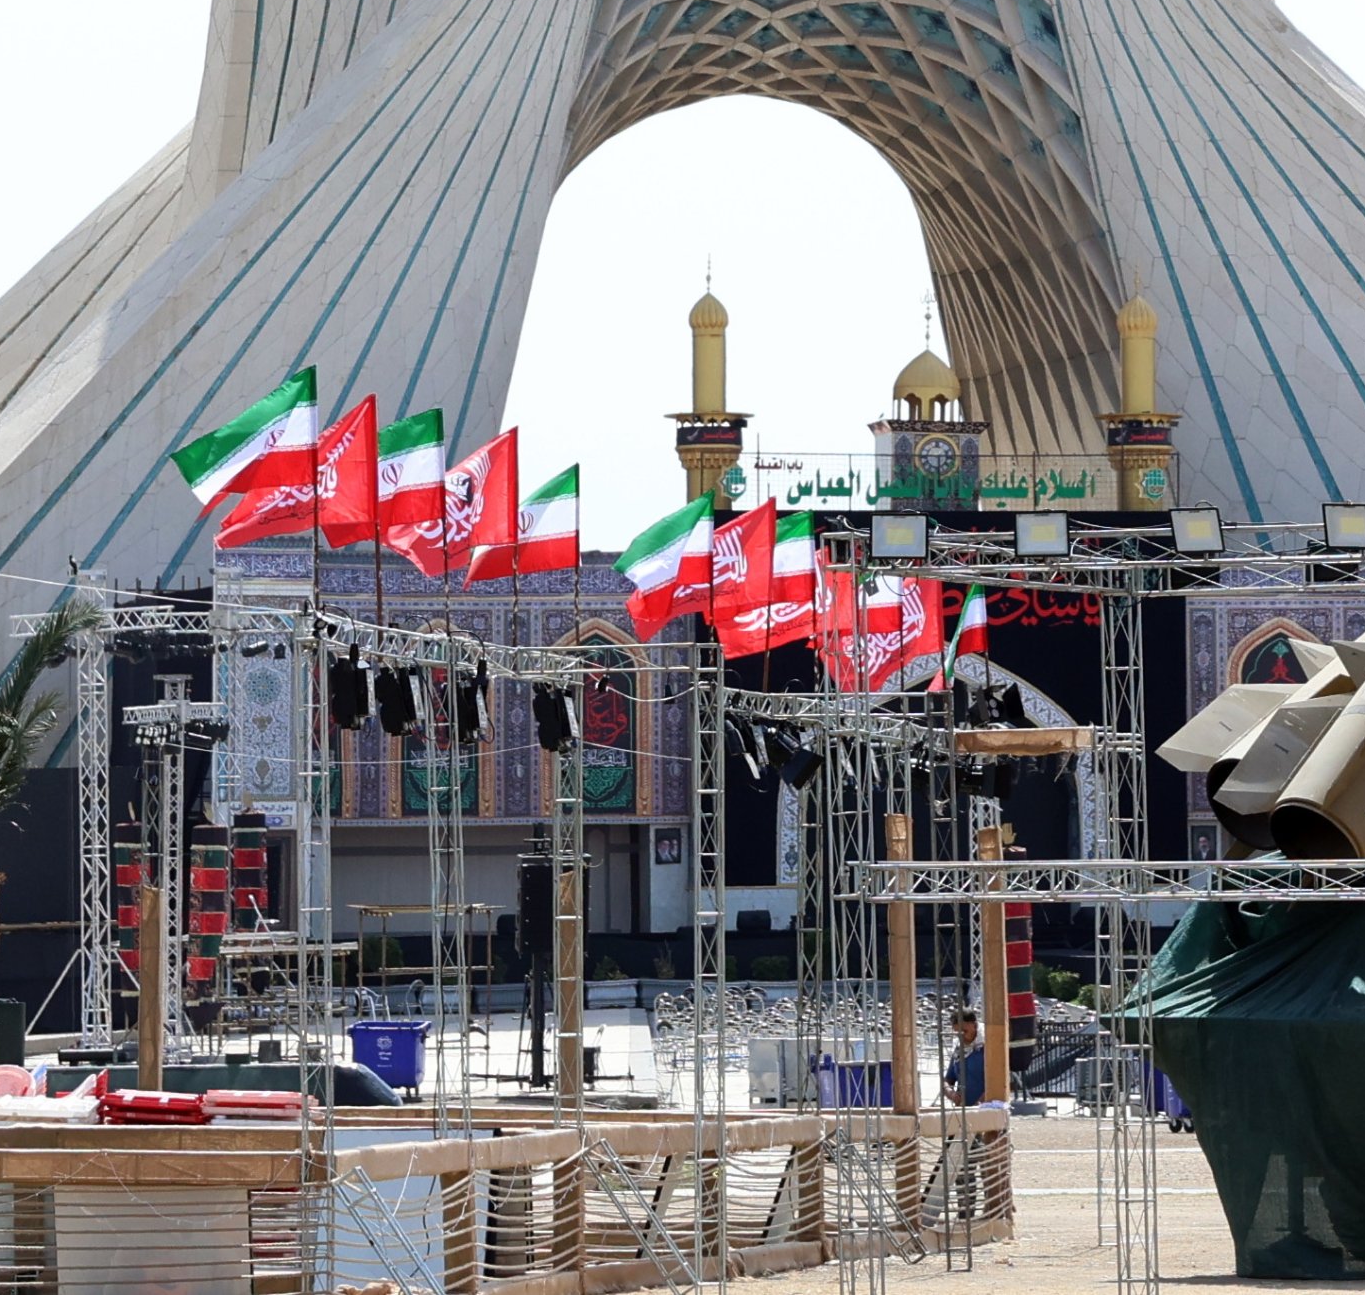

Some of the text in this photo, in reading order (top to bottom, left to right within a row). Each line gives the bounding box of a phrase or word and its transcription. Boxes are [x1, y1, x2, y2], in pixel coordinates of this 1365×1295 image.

[786, 468, 861, 506] العباس
[979, 467, 1029, 508] عليك
[1035, 467, 1097, 507] السلام
